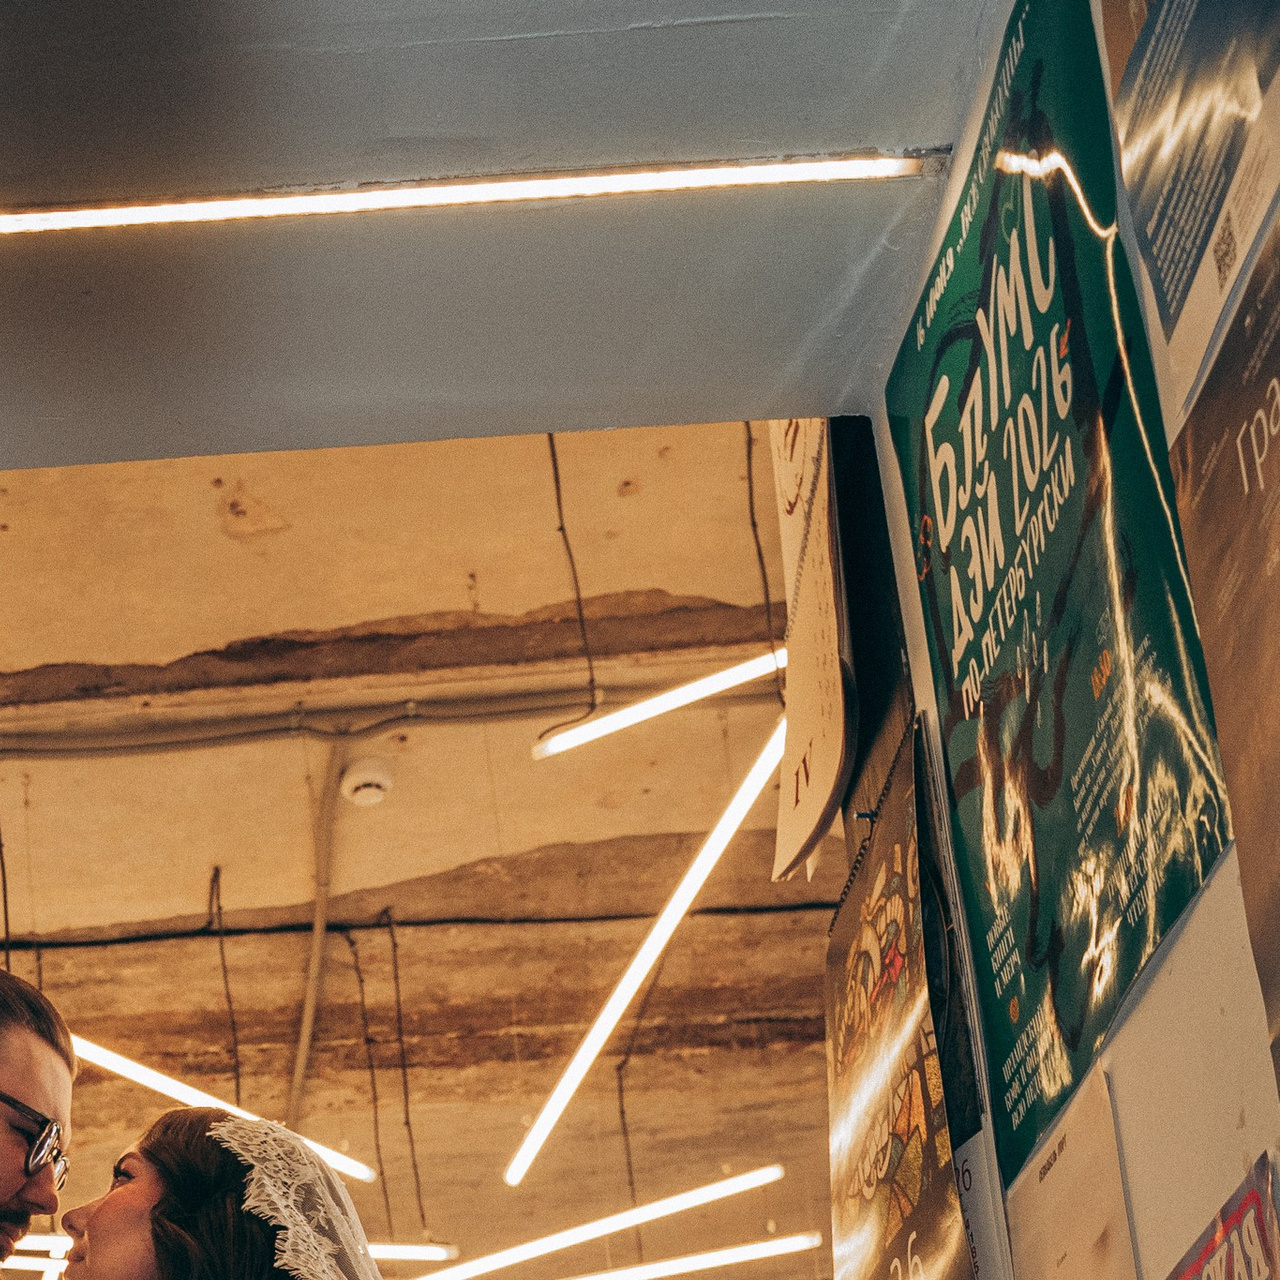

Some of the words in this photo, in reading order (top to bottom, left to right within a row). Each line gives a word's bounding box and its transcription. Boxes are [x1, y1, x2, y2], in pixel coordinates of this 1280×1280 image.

[924, 152, 1055, 554] БЛУМС
[949, 459, 1006, 681] ДЭЙ
[1003, 322, 1074, 538] 2026
[961, 434, 1077, 722] ПО-ПЕТЕРБУРГСКИ
